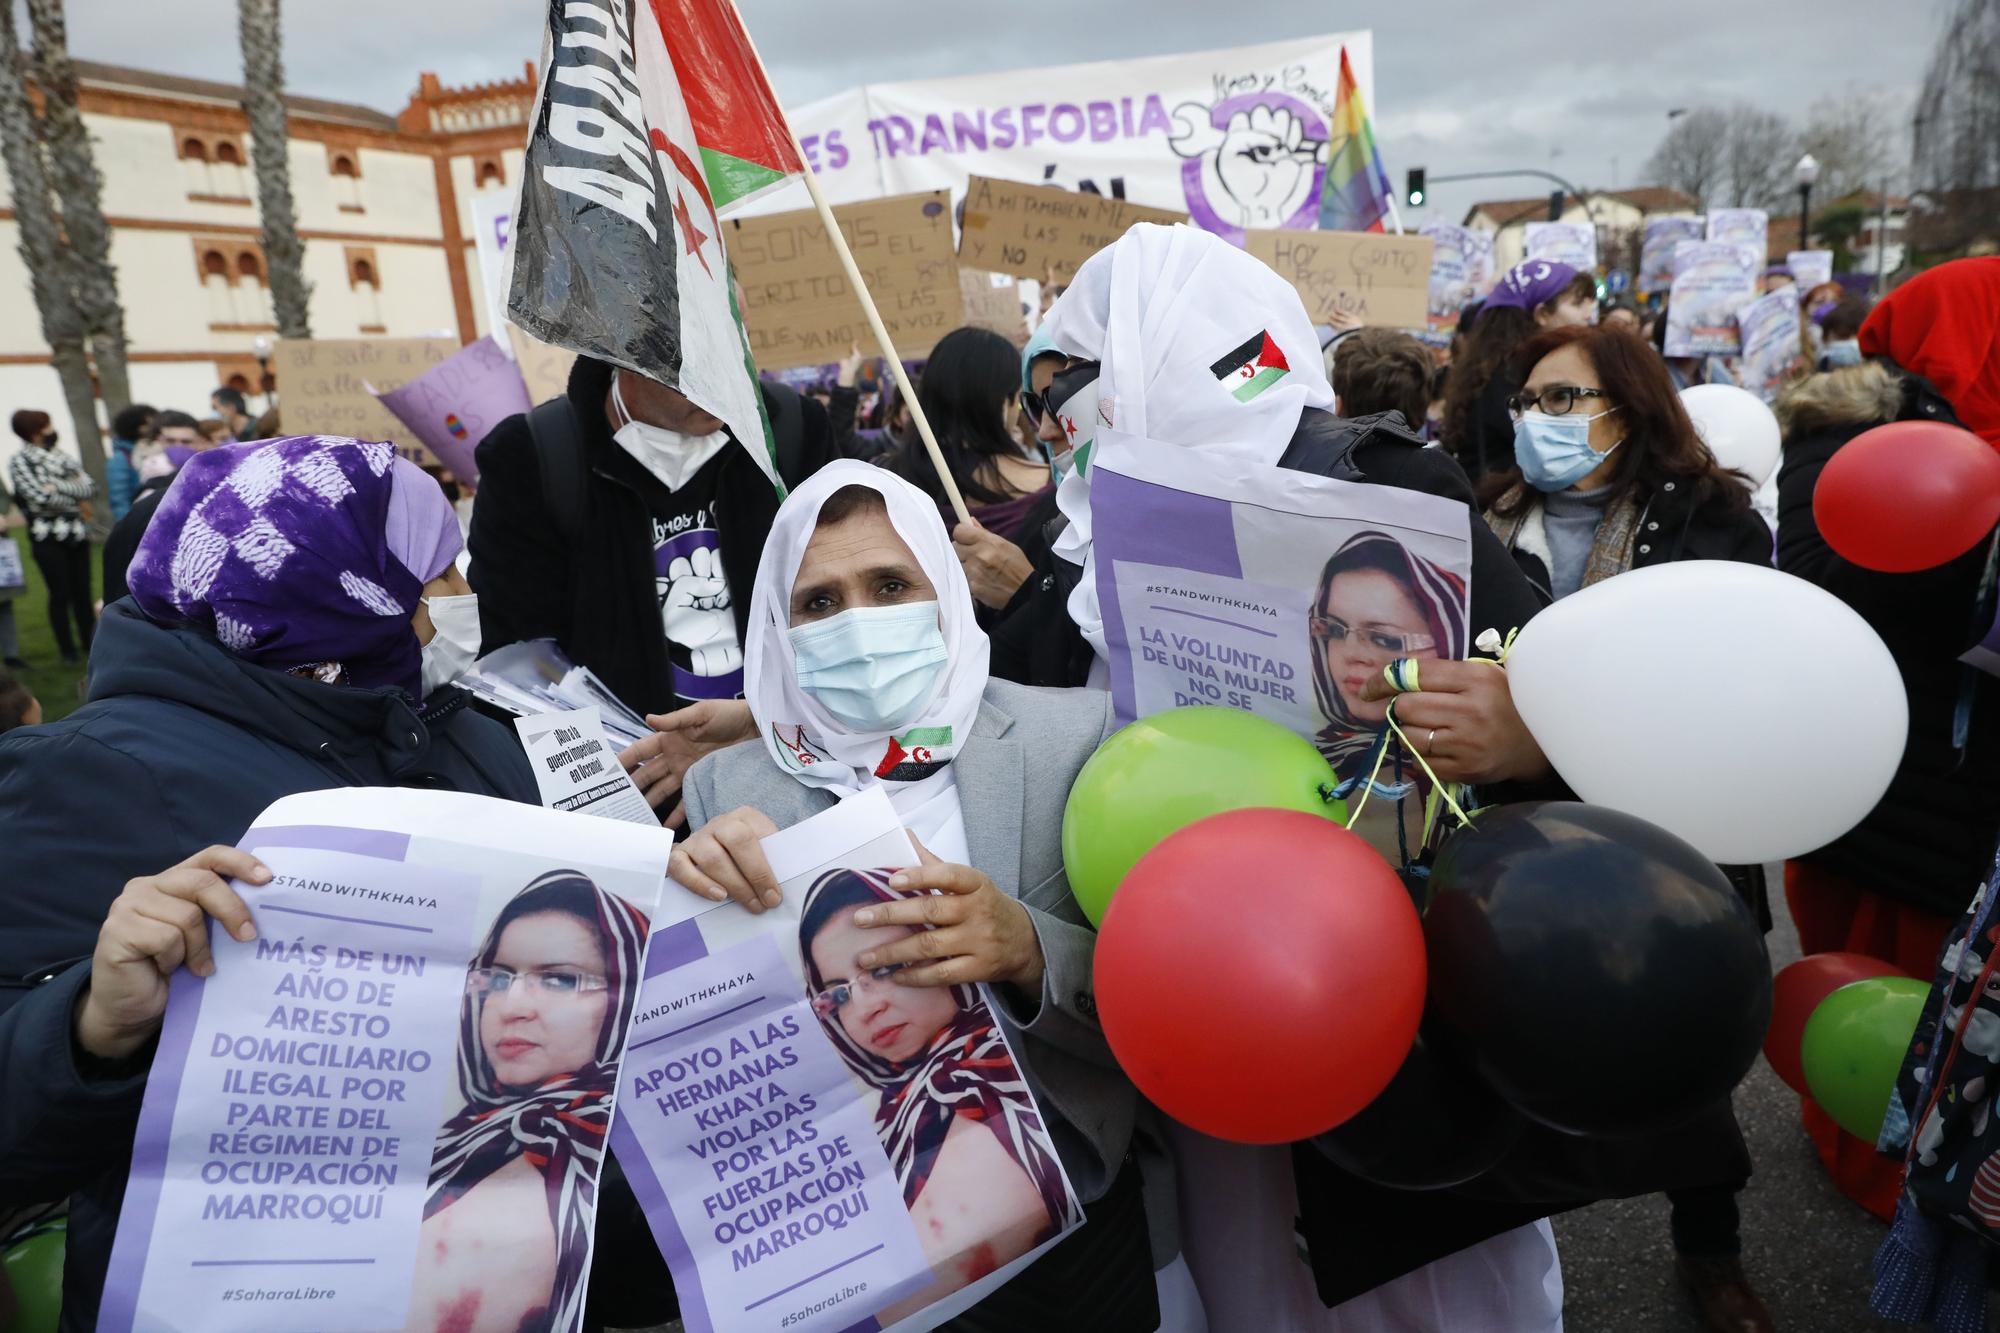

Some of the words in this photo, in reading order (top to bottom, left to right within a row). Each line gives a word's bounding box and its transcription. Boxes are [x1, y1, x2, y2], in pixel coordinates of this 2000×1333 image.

[867, 94, 1174, 159] TRANSFOBIA
[887, 234, 926, 255] EL
[1023, 223, 1058, 243] LAS
[974, 241, 985, 259] Y
[1002, 244, 1027, 266] NO
[1274, 239, 1320, 268] HOY
[746, 275, 846, 308] GRITO
[1296, 266, 1336, 290] POR
[1356, 269, 1374, 291] TI
[897, 286, 936, 311] LAS
[750, 327, 794, 350] QUE
[797, 330, 825, 350] YA
[826, 324, 853, 344] NO
[905, 311, 945, 329] VOZ
[652, 514, 694, 545] bres
[1146, 584, 1278, 617] #STANDWITHKHAYA
[1139, 626, 1167, 646] LA
[1170, 632, 1295, 681] VOLUNTAD
[1142, 646, 1170, 667] DE
[1173, 656, 1218, 683] UNA
[1225, 670, 1298, 704] MUJER
[1189, 676, 1221, 700] NO
[1228, 690, 1253, 711] SE
[546, 750, 573, 772] guerra
[569, 769, 582, 783] en
[255, 936, 327, 967] MÁS
[335, 948, 374, 971] DE
[381, 952, 426, 977] UN
[274, 967, 348, 1002] AÑO
[356, 980, 396, 1007] DE
[634, 972, 755, 1025] TANDWITHKHAYA
[265, 1005, 390, 1039] ARESTO
[210, 1032, 431, 1073] DOMICILIARIO
[633, 1047, 723, 1098] APOYO
[729, 1037, 750, 1060] A
[749, 1015, 800, 1050] LAS
[222, 1069, 331, 1099] ILEGAL
[341, 1076, 406, 1102] POR
[656, 1046, 799, 1117] HERMANAS
[227, 1102, 329, 1128] PARTE
[336, 1107, 391, 1130] DEL
[694, 1082, 789, 1131] KHAYA
[208, 1127, 354, 1157] RÉGIMEN
[361, 1136, 400, 1157] DE
[687, 1093, 817, 1160] VIOLADAS
[712, 1144, 769, 1182] POR
[768, 1119, 819, 1156] LAS
[201, 1157, 398, 1185] OCUPACIÓN
[702, 1152, 816, 1219] FUERZAS
[817, 1135, 852, 1167] DE
[202, 1186, 387, 1224] MARROQUÍ
[714, 1160, 866, 1244] OCUPACIÓN
[731, 1183, 870, 1273] MARROQUÍ
[222, 1287, 336, 1301] #SaharaLibre
[780, 1282, 868, 1328] #SaharaLibre
